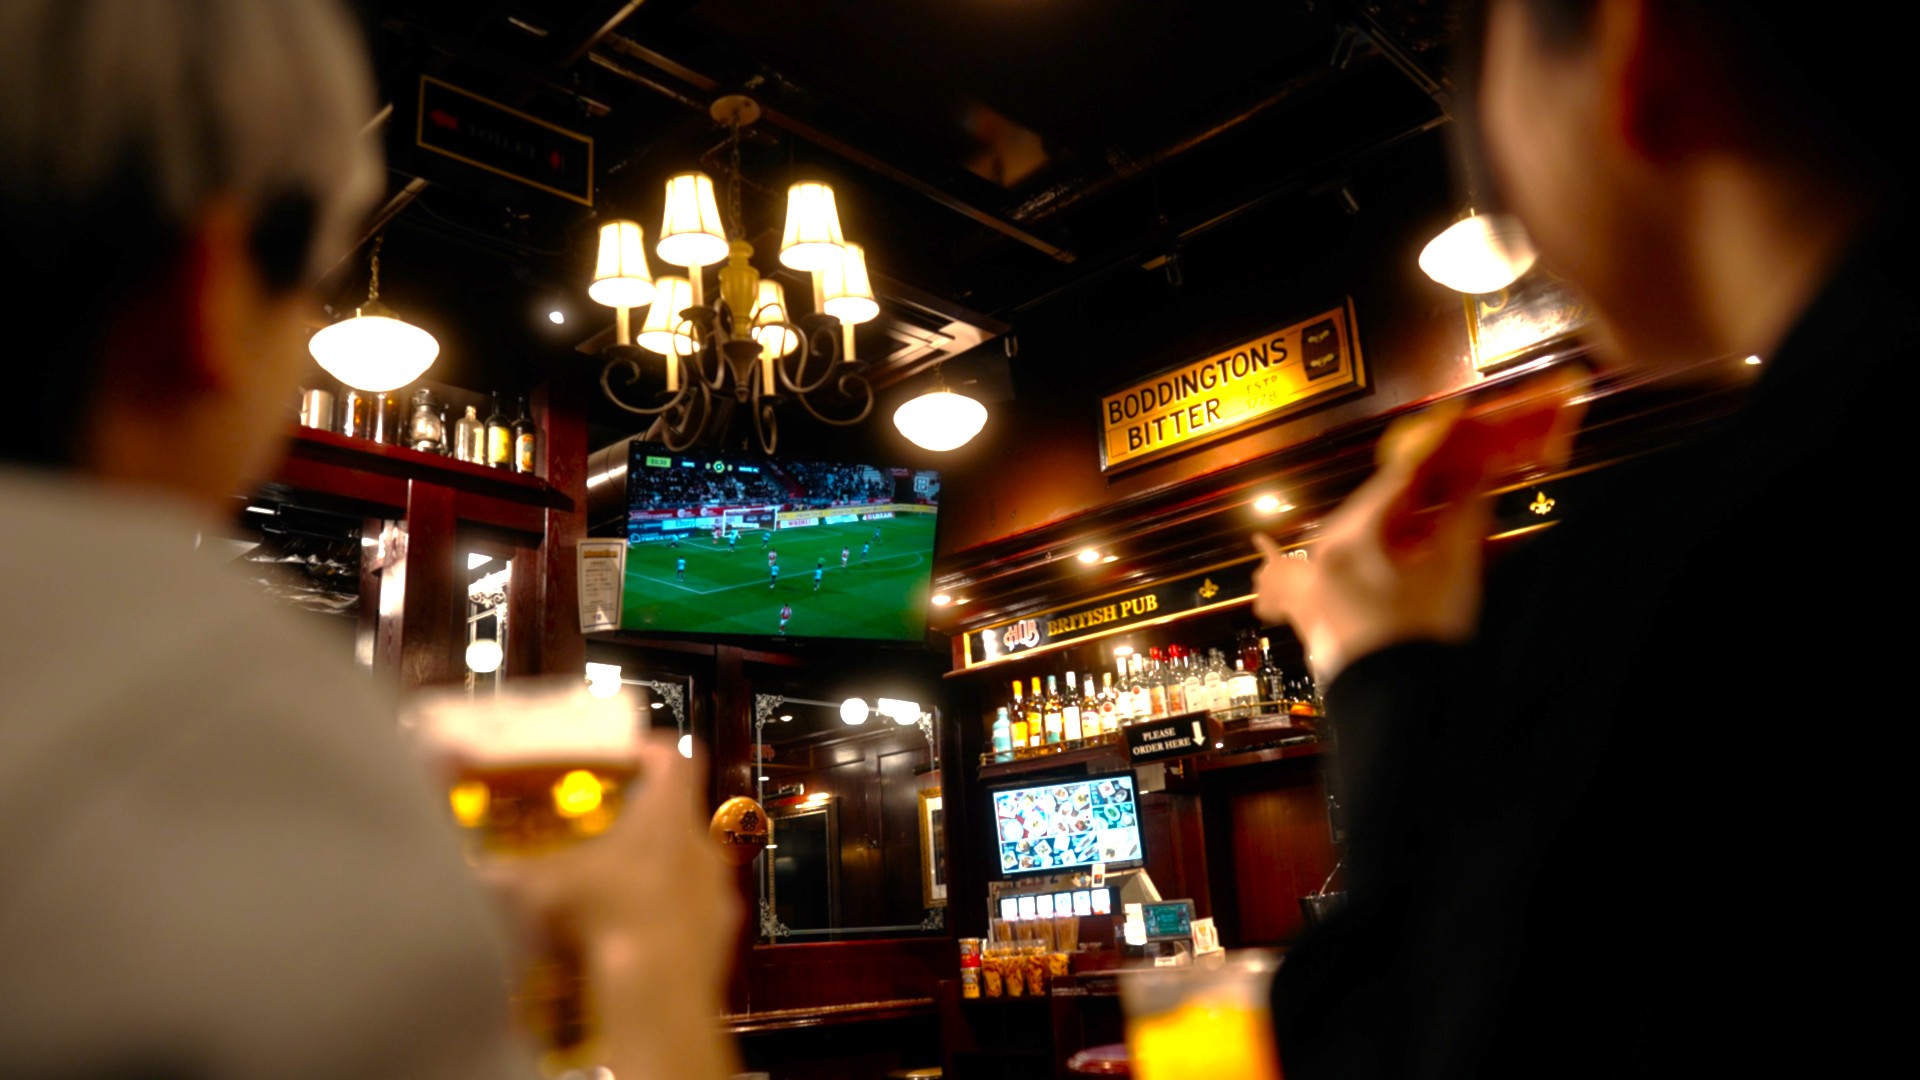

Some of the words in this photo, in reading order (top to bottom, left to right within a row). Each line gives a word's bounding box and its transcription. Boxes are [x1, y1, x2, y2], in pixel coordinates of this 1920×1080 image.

[1109, 338, 1288, 424] BODDINGTONS
[1128, 398, 1221, 451] BITTER
[1003, 619, 1040, 651] HUB
[1048, 606, 1117, 635] BRITISH
[1120, 594, 1158, 617] PUB
[1132, 740, 1165, 756] ORDER
[1164, 737, 1192, 750] HERE
[1142, 726, 1176, 742] PLEASE
